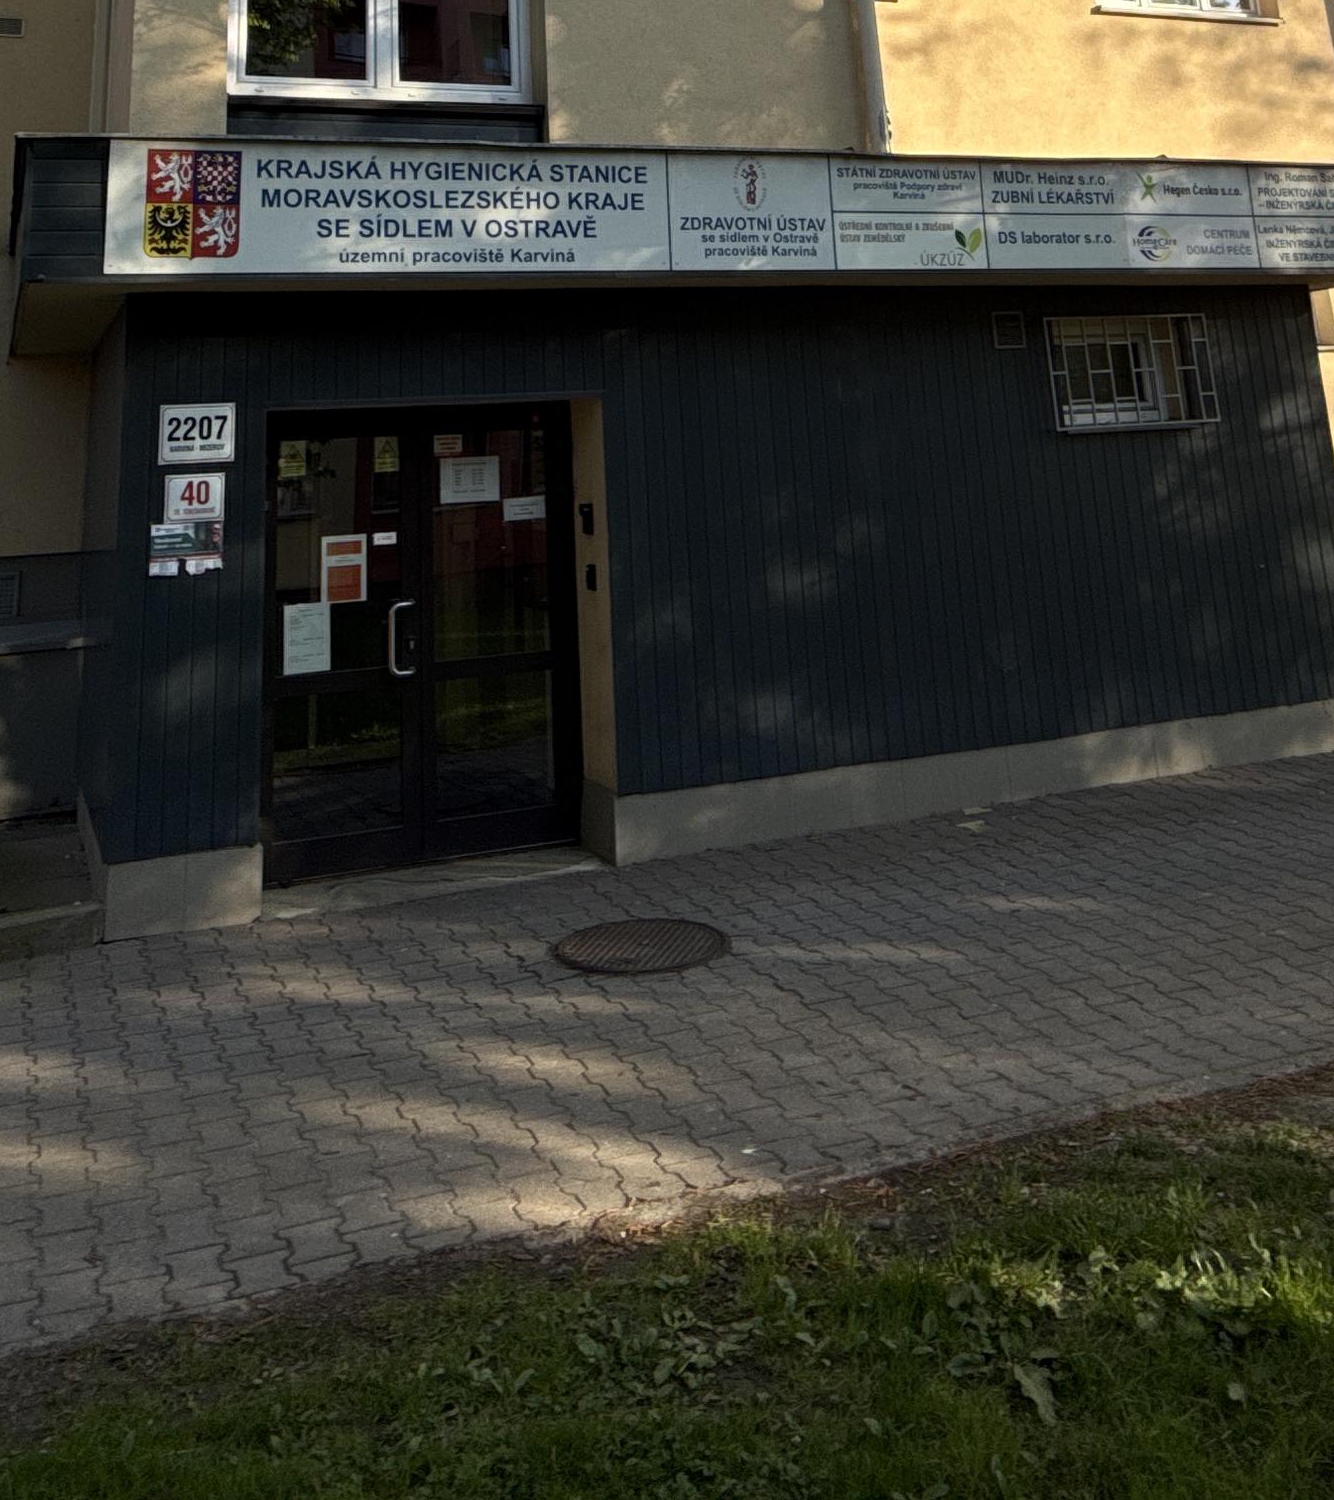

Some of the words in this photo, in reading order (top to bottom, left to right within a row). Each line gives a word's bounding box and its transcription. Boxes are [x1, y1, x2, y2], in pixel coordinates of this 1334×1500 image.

[256, 156, 382, 179] KRAJSKÁ
[389, 159, 543, 182] HYGIENICKÁ
[549, 164, 648, 184] STANICE
[836, 165, 876, 178] STÁTNÍ
[879, 167, 940, 180] ZDRAVOTNÍ
[942, 167, 976, 180] ÚSTAV
[993, 171, 1034, 185] MUDr.
[1038, 172, 1075, 185] Heinz
[1264, 172, 1283, 184] Ing.
[1285, 172, 1317, 182] Roman
[260, 187, 560, 210] MORAVSKOSLEZSKÉHO
[568, 192, 645, 211] KRAJE
[991, 188, 1035, 204] ZUBNÍ
[1038, 188, 1115, 205] LÉKAŘSTVÍ
[1257, 187, 1327, 198] PROJEKTOVÁNÍ
[317, 218, 350, 238] SE
[358, 214, 453, 238] SÍDLEM
[461, 219, 477, 238] V
[485, 215, 597, 239] OSTRAVĚ
[680, 214, 772, 231] ZDRAVOTNÍ
[777, 214, 827, 231] ÚSTAV
[701, 234, 716, 243] se
[763, 235, 770, 243] v
[998, 231, 1017, 244] DS
[1021, 231, 1081, 244] laborator
[1084, 233, 1116, 244] s.r.o.
[1204, 229, 1250, 239] CENTRUM
[339, 248, 405, 263] územní
[412, 248, 504, 266] pracoviště
[510, 248, 576, 263] Karviná
[705, 246, 768, 258] pracoviště
[771, 246, 818, 257] Karviná
[920, 250, 965, 267] ÚKZÚZ
[1278, 252, 1292, 261] VE
[167, 415, 228, 442] 2207
[180, 480, 210, 506] 40
